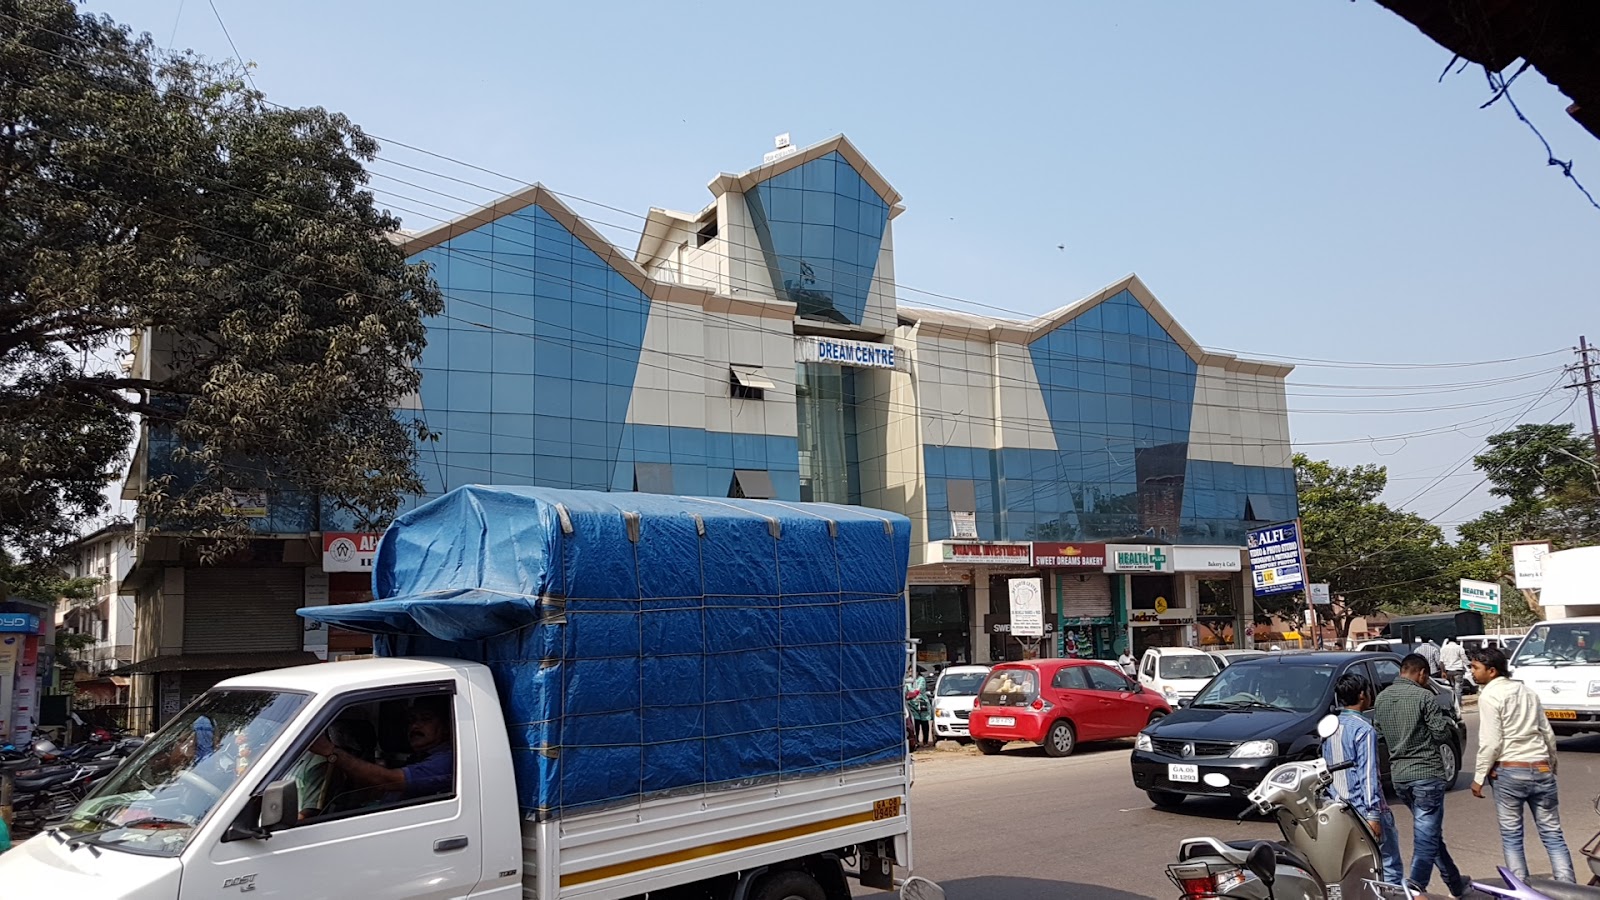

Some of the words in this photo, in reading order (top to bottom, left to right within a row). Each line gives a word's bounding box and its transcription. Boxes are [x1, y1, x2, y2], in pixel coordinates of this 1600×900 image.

[819, 342, 854, 361] DREAM
[855, 346, 894, 365] CENTRE
[1258, 528, 1285, 546] ALFI
[1118, 552, 1149, 564] HEALTH
[1250, 548, 1263, 557] VIDEO
[1036, 556, 1056, 566] SWEET
[1056, 556, 1081, 566] DREAMS
[1081, 556, 1103, 566] BAKERY
[1208, 561, 1222, 569] Bakery
[1462, 587, 1484, 596] HEALTH
[223, 874, 258, 888] DOST
